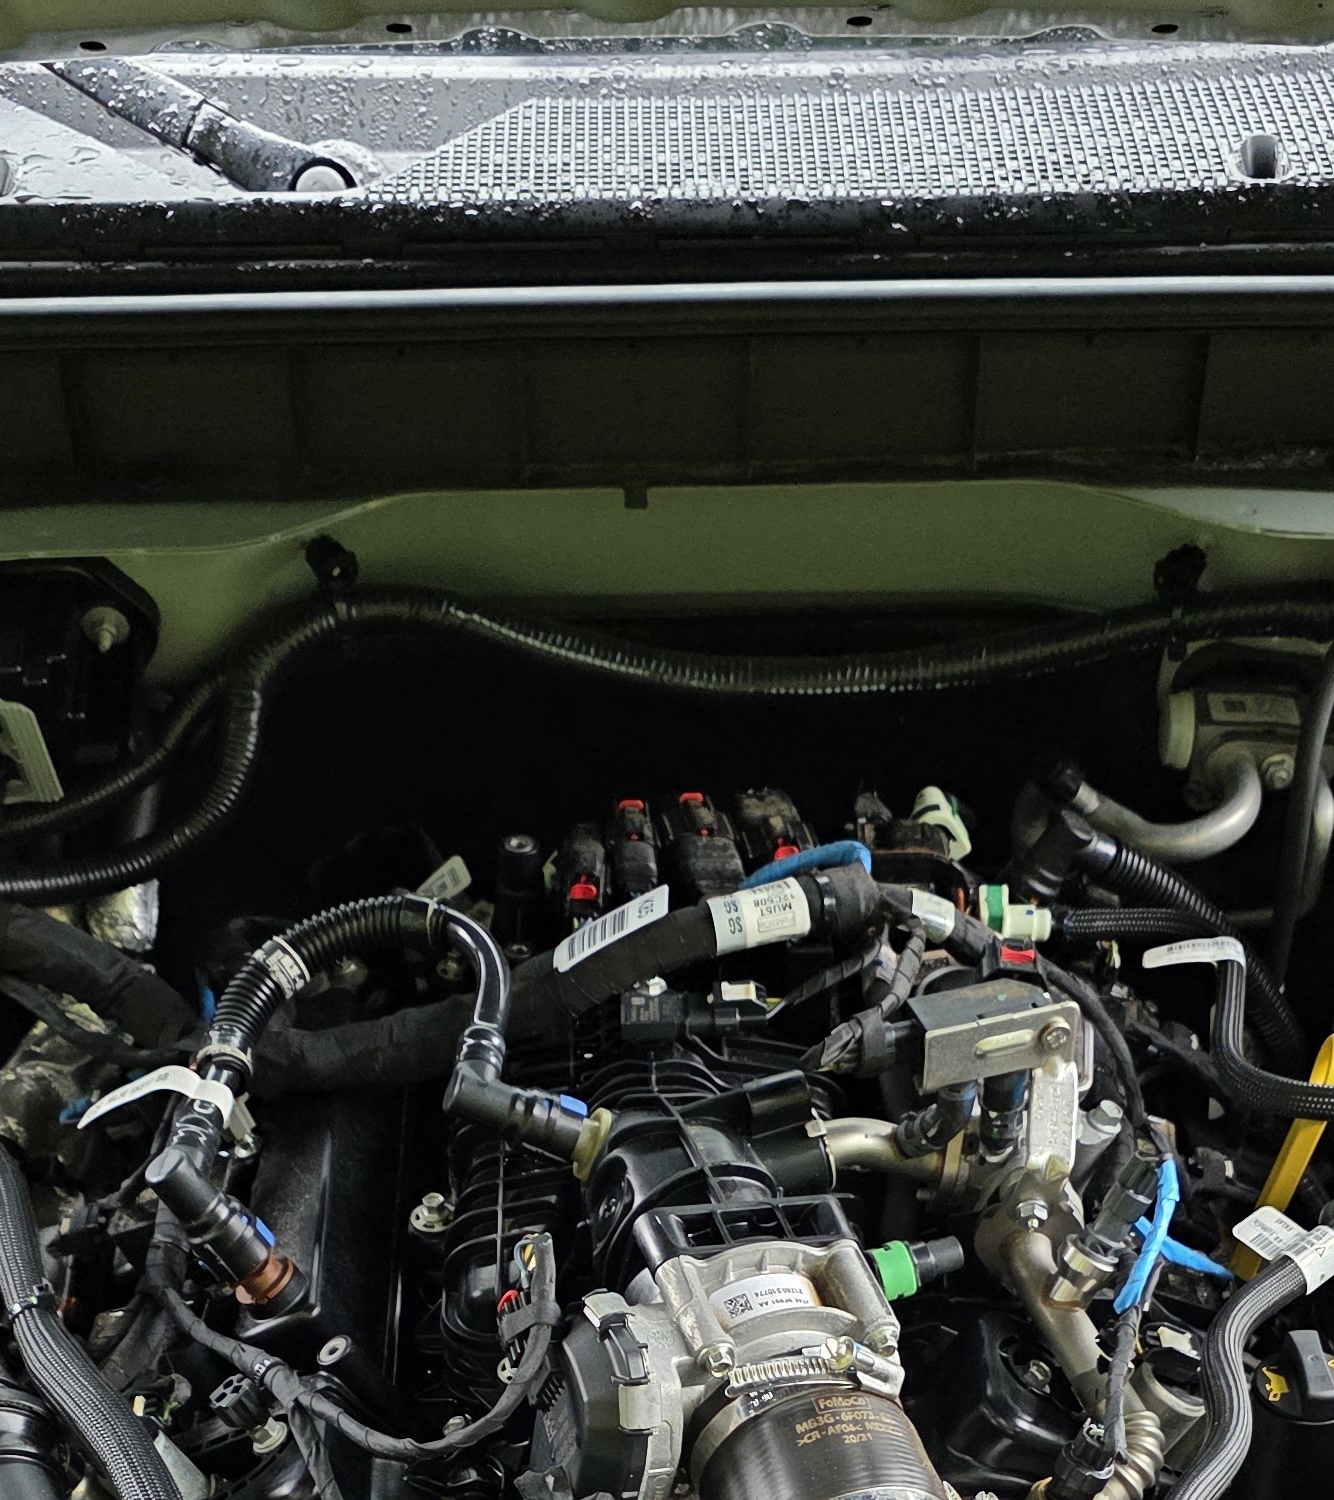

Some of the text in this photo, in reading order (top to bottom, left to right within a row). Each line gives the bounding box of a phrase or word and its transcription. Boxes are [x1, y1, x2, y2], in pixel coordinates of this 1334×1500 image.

[757, 1300, 769, 1308] AA
[818, 1396, 866, 1410] FoMoCo
[842, 1432, 874, 1445] 20/21
